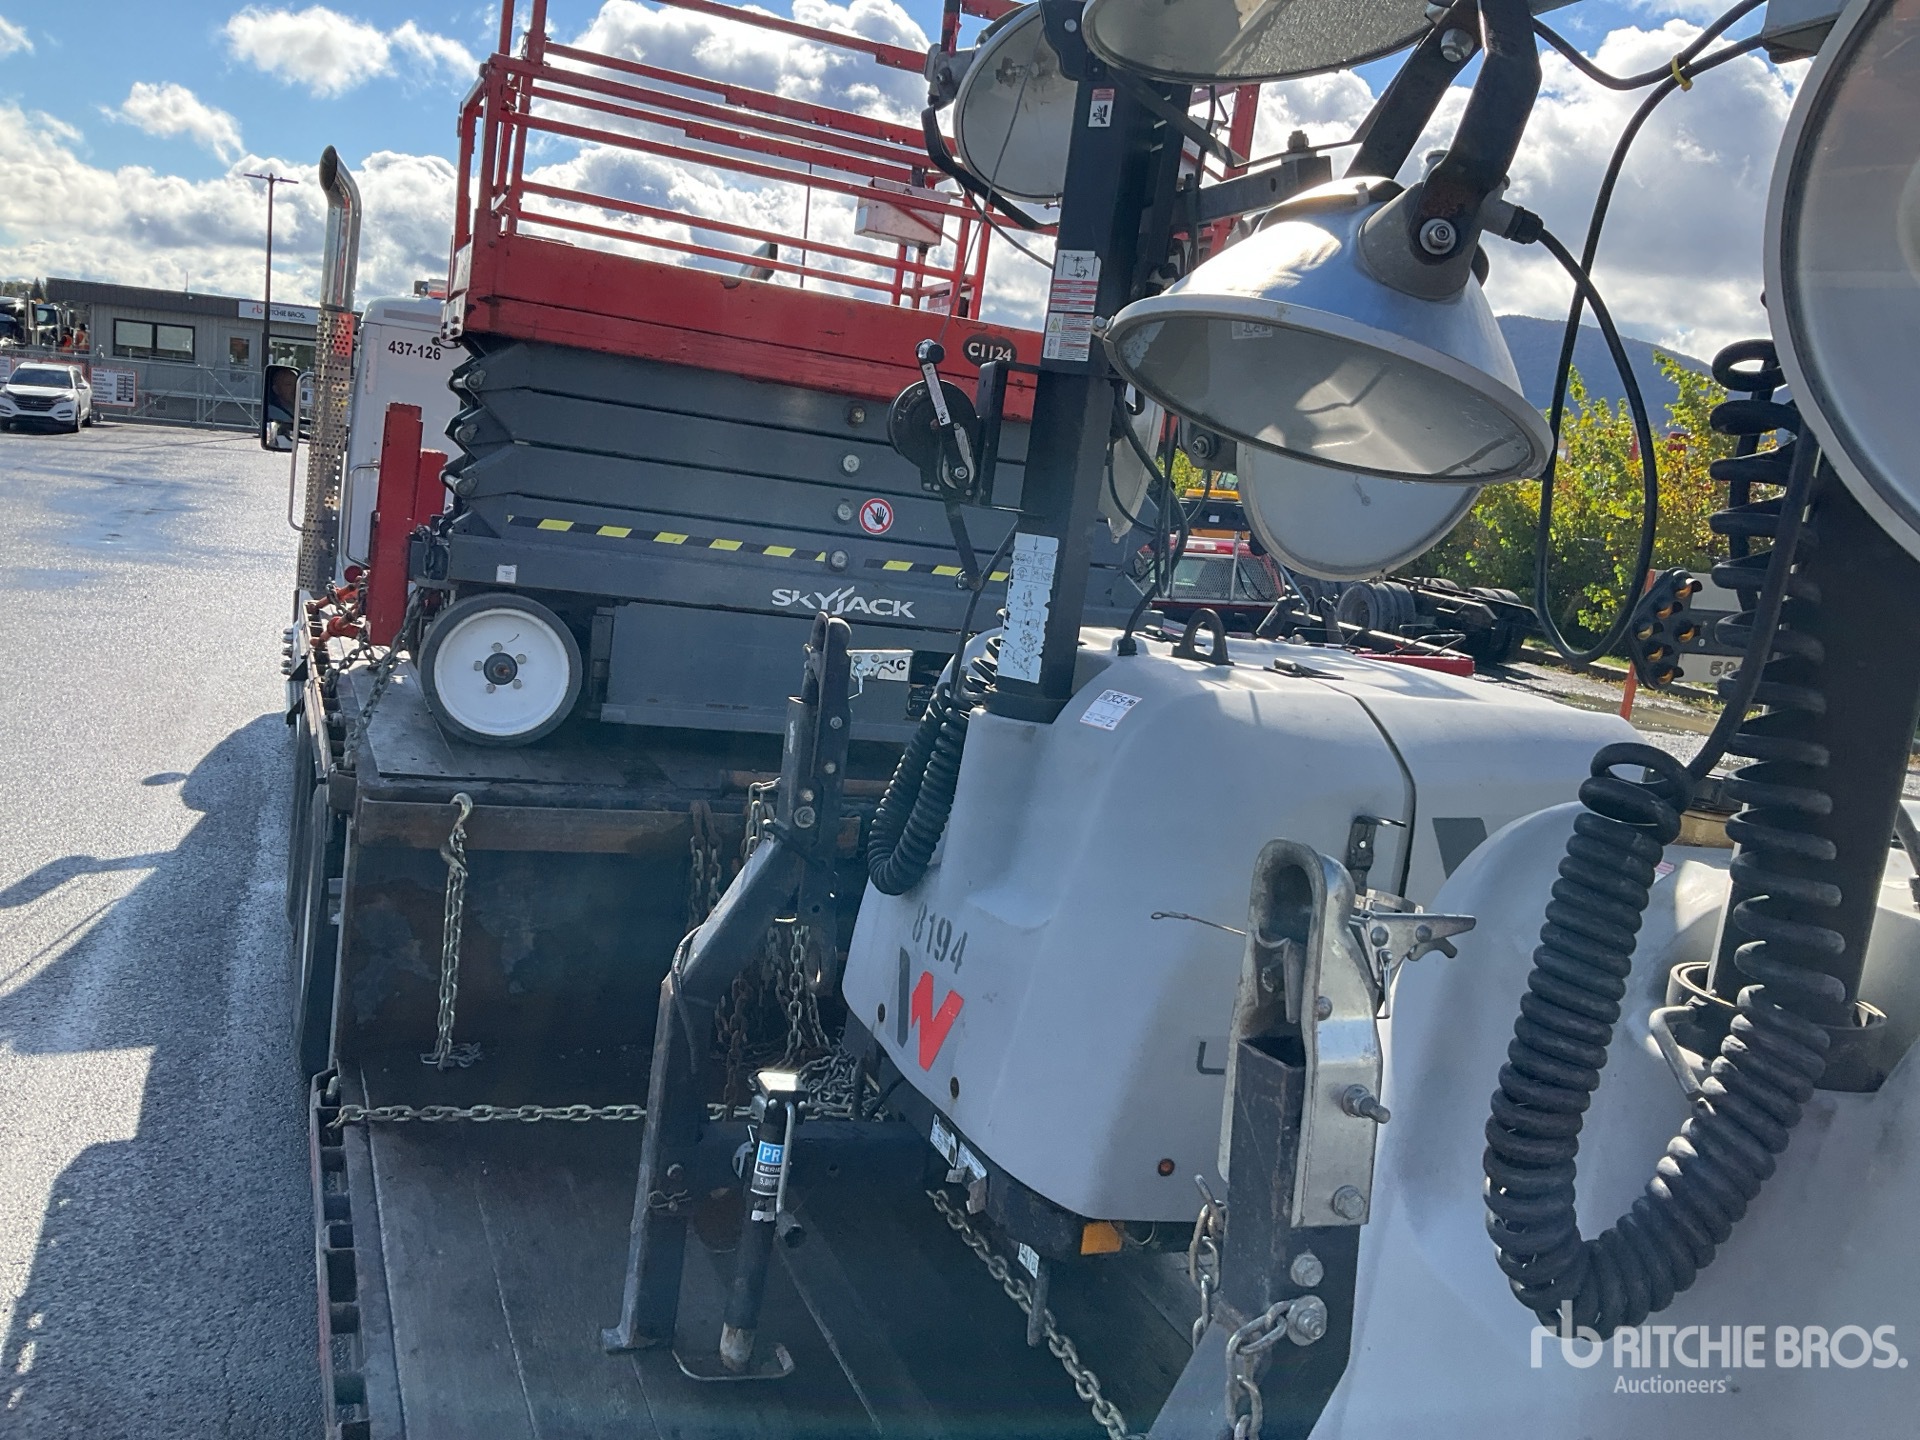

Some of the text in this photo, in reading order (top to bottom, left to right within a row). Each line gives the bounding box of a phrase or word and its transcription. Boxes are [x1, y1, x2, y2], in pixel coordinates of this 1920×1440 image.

[388, 340, 441, 360] 437-126
[771, 585, 916, 619] SKYJACK
[912, 901, 968, 975] 8194
[761, 1146, 781, 1162] PR
